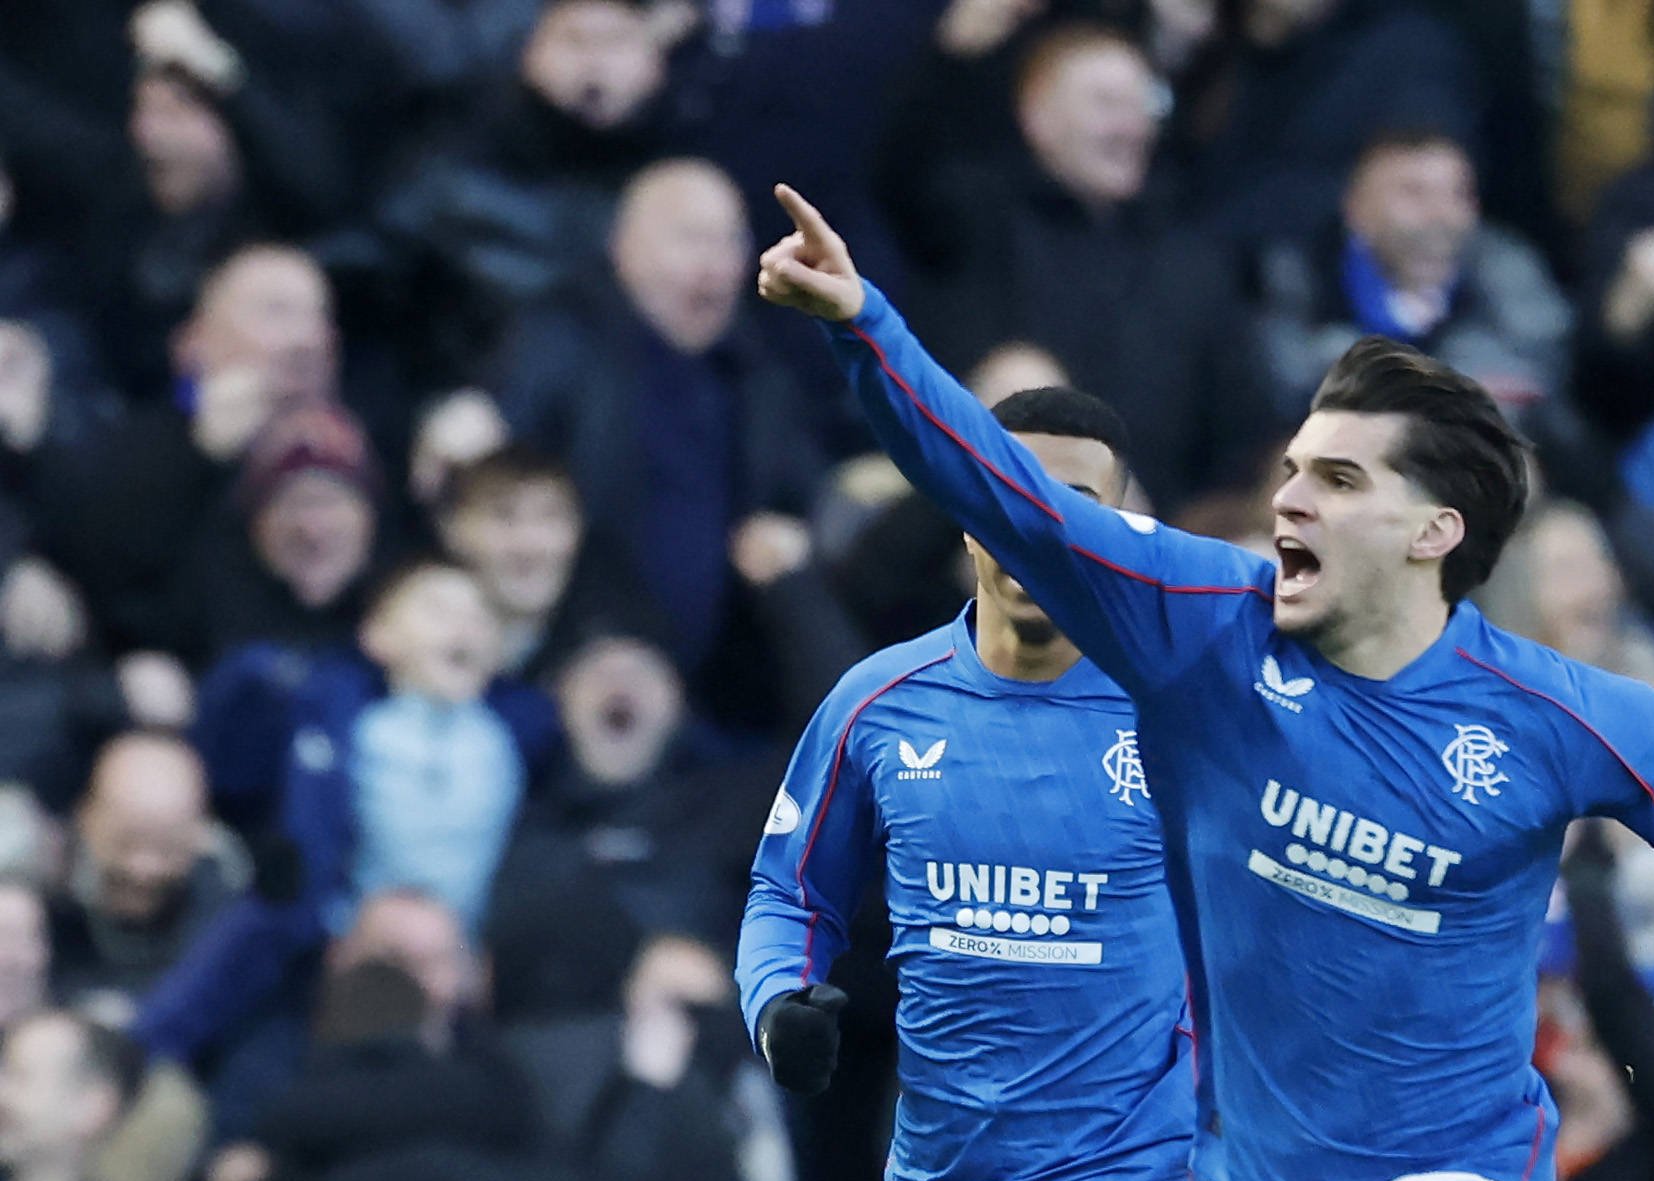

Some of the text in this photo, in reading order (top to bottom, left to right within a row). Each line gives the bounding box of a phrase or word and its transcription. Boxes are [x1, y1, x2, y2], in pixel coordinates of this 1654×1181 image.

[1260, 779, 1463, 888] UNIBET
[926, 861, 1109, 911] UNIBET
[948, 934, 1079, 961] ZERO% MISSION
